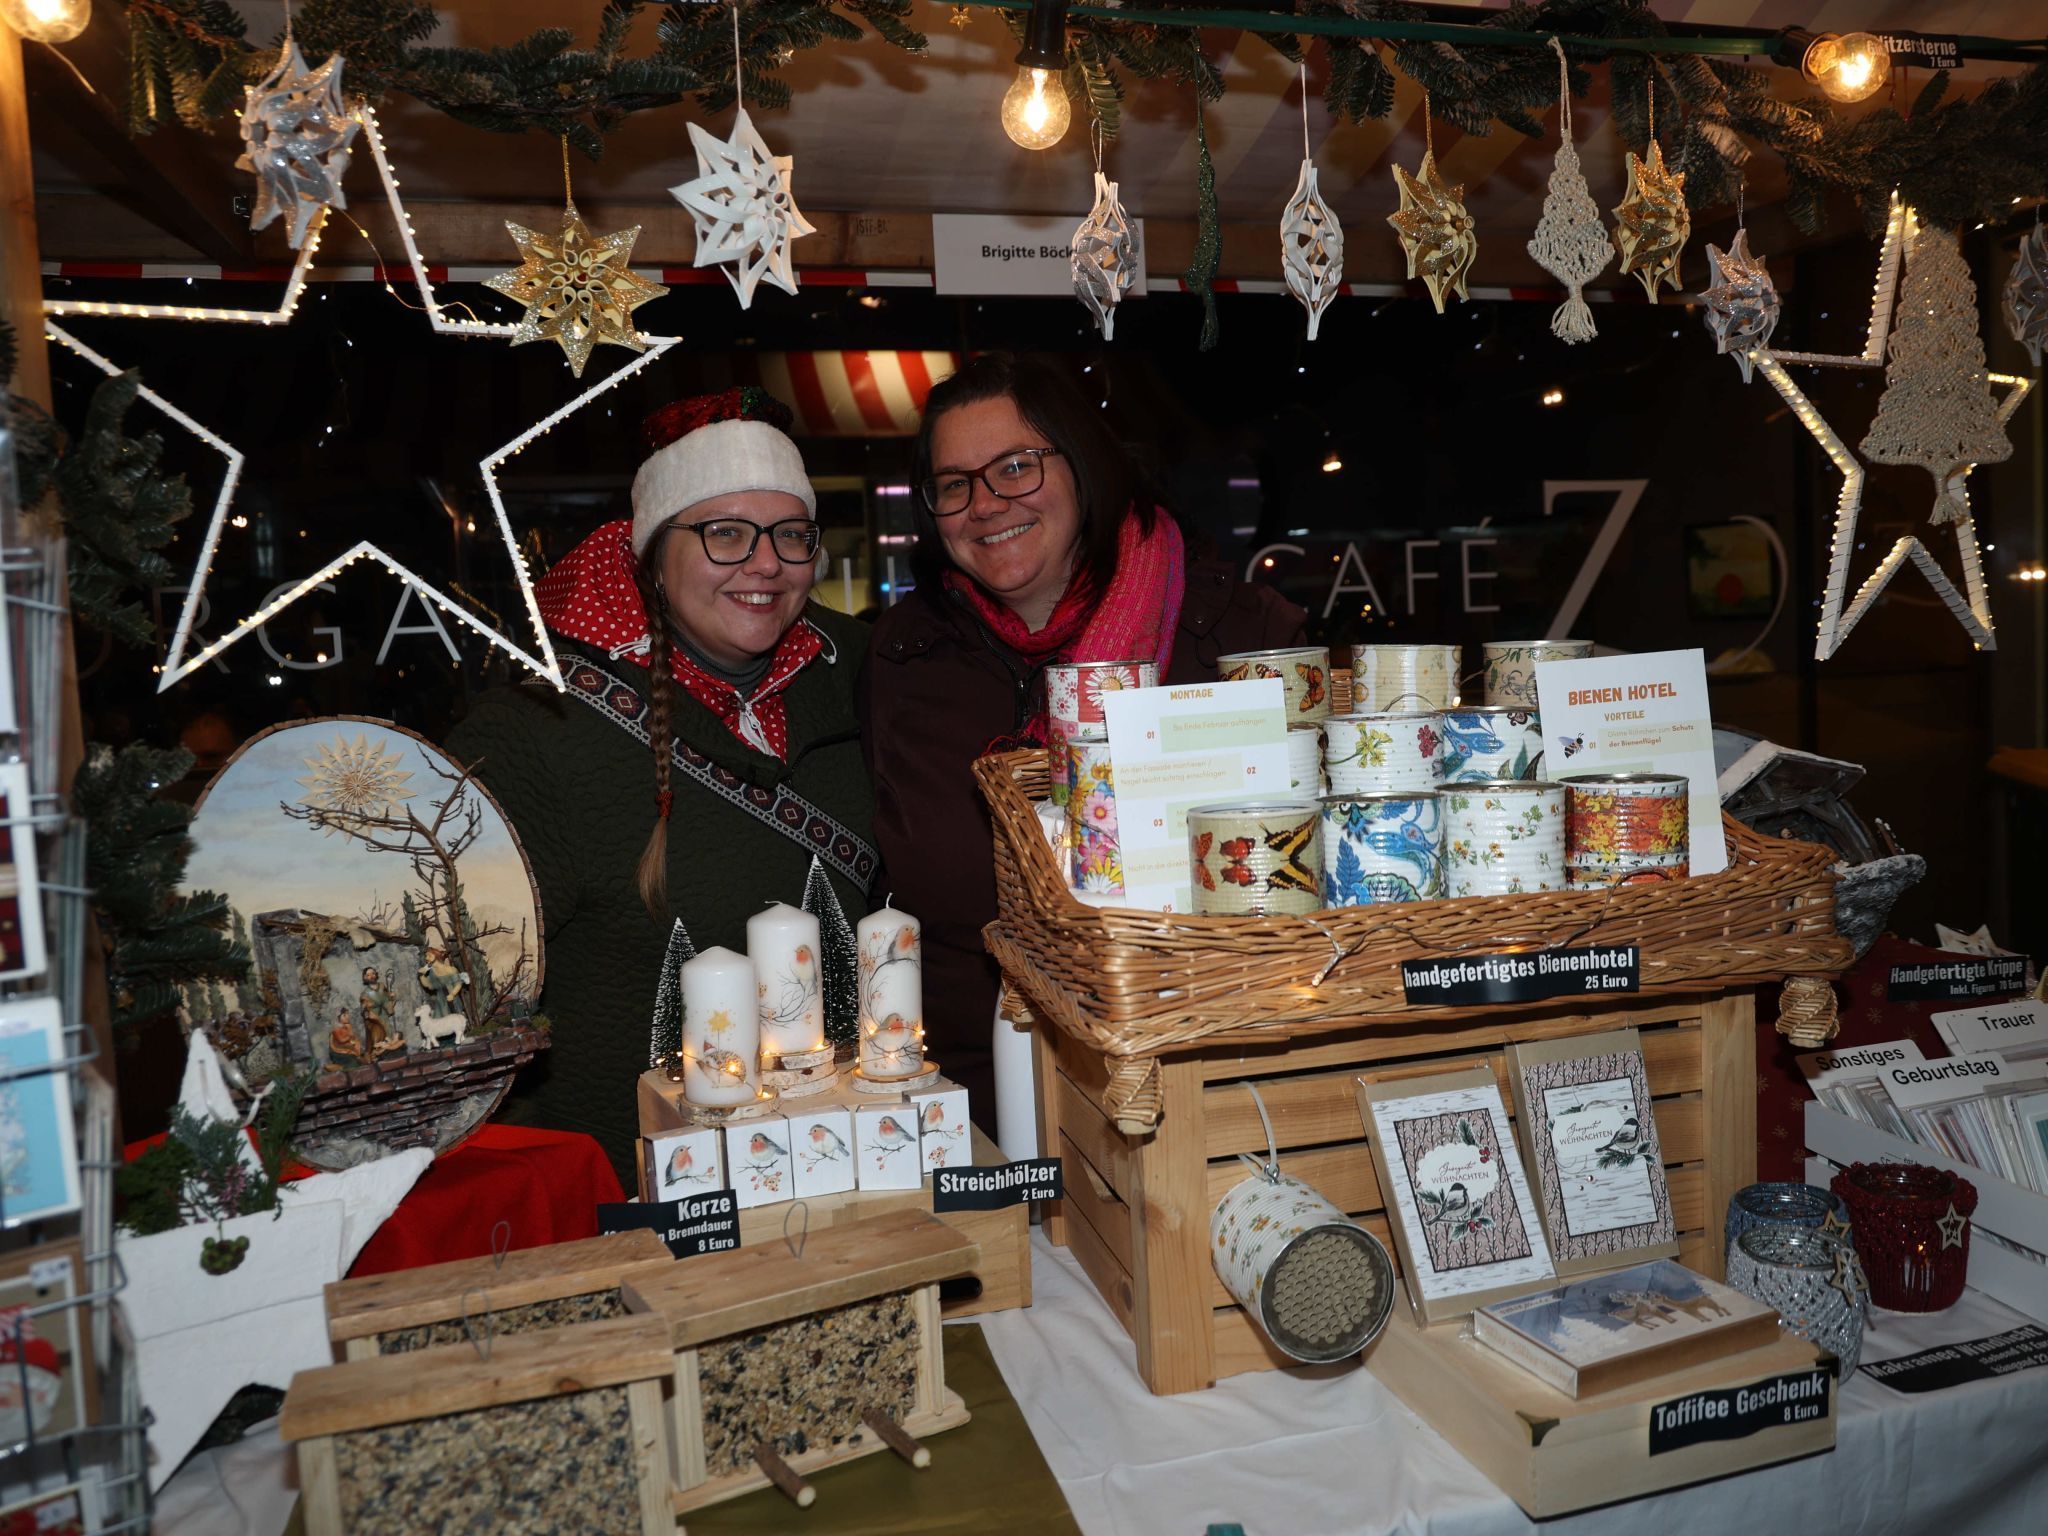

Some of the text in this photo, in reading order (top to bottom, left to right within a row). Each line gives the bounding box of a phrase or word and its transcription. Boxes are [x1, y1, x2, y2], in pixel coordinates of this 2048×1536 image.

[1930, 57, 1956, 67] 7 Euro
[981, 245, 1074, 261] Brigitte Böck
[1244, 515, 1501, 619] CAFÉ
[1170, 688, 1213, 700] MONTAGE
[1568, 682, 1677, 706] BIENEN HOTEL
[1604, 710, 1645, 721] VORTEILE
[1147, 731, 1155, 739] 01
[1672, 724, 1694, 732] Schutz
[1609, 736, 1662, 748] der Bienenflügel
[1247, 766, 1256, 775] 02
[1153, 818, 1163, 827] 03
[1162, 904, 1172, 913] 05
[1403, 948, 1634, 989] handgefertigtes Bienenhotel
[1890, 959, 2023, 985] Handgefertigte Krippe
[1585, 975, 1628, 990] 25 Euro
[1950, 984, 1970, 995] Inkl.
[2008, 979, 2023, 989] Euro
[1978, 1013, 2036, 1032] Trauer
[1815, 1047, 1905, 1071] Sonstiges
[1892, 1058, 2000, 1085] Geburtstag
[1560, 1130, 1613, 1145] WEIHNACHTEN
[940, 1164, 1057, 1193] Streichhölzer
[1431, 1171, 1489, 1184] WEIHNACHTEN
[1022, 1188, 1055, 1200] 2 Euro
[678, 1197, 731, 1221] Kerze
[668, 1220, 733, 1241] Brenndauer
[698, 1238, 734, 1251] 8 Euro
[1863, 1326, 2043, 1378] Makramee Windlicht
[1657, 1373, 1824, 1432] Toffifee Geschenk
[1784, 1405, 1818, 1421] 8 Euro
